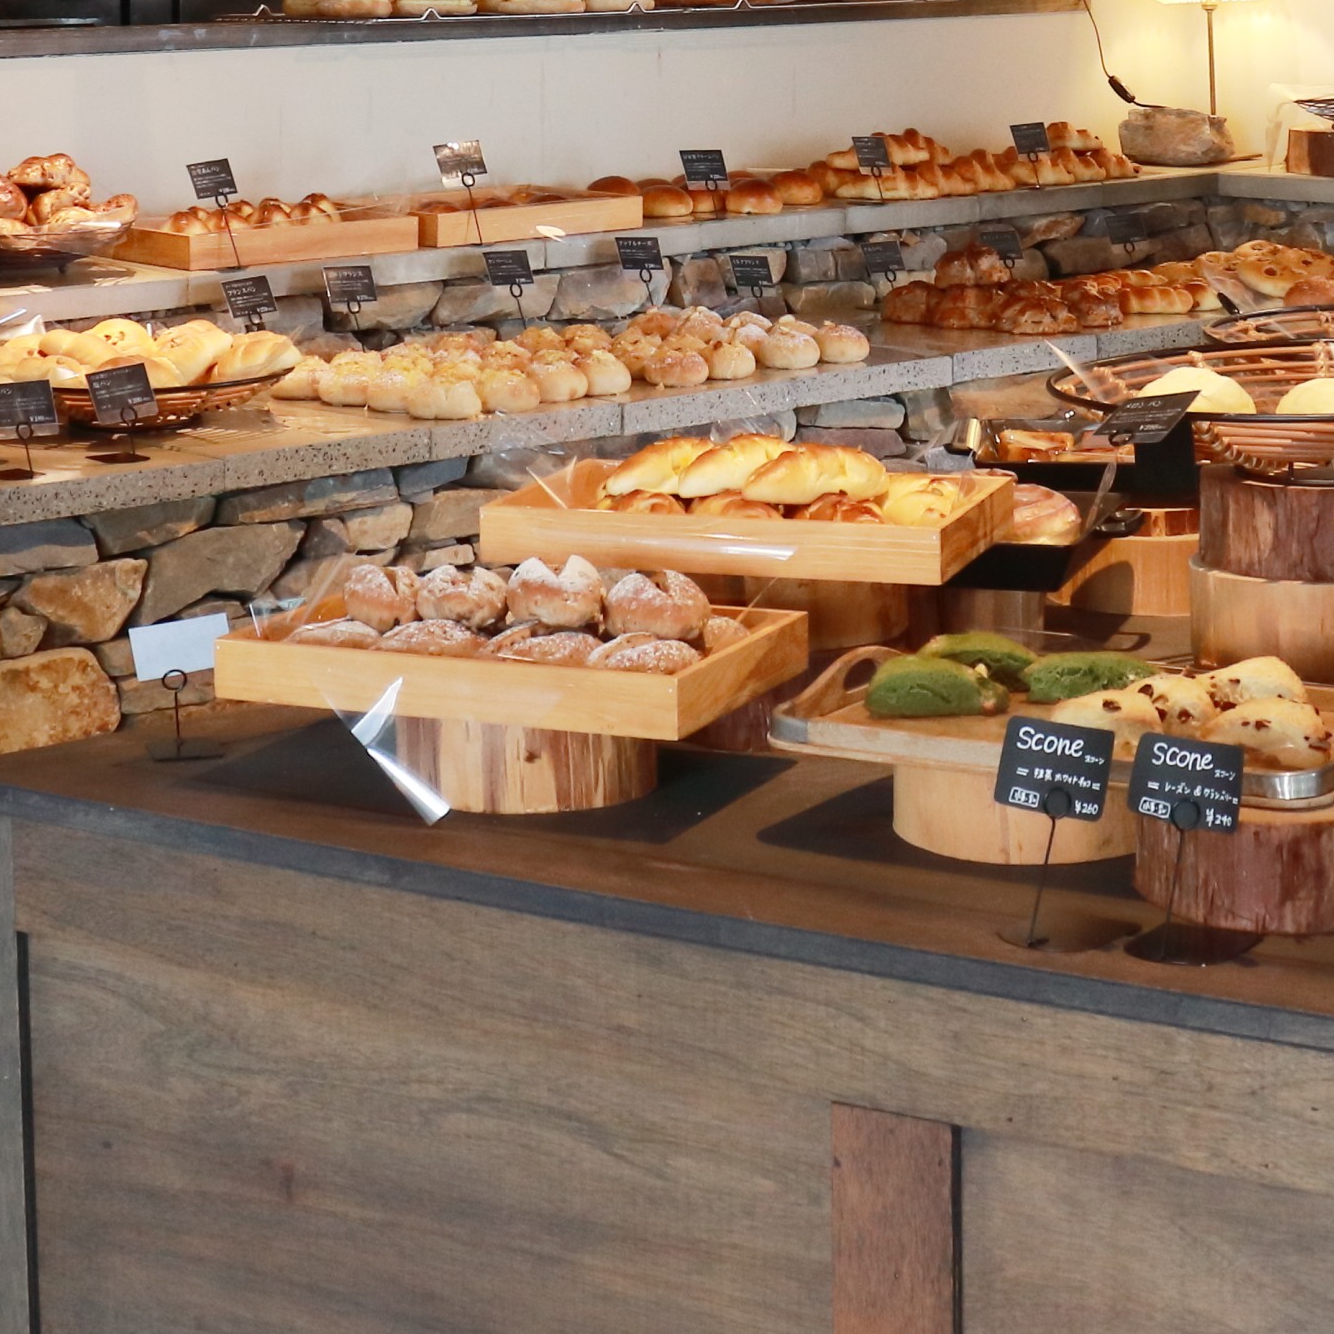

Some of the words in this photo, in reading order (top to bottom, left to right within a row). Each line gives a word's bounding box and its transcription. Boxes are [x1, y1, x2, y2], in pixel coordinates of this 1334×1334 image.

[1016, 726, 1084, 758] Scone
[1151, 742, 1214, 771] Scone
[1074, 800, 1099, 815] ¥260
[1205, 808, 1233, 827] ¥240
